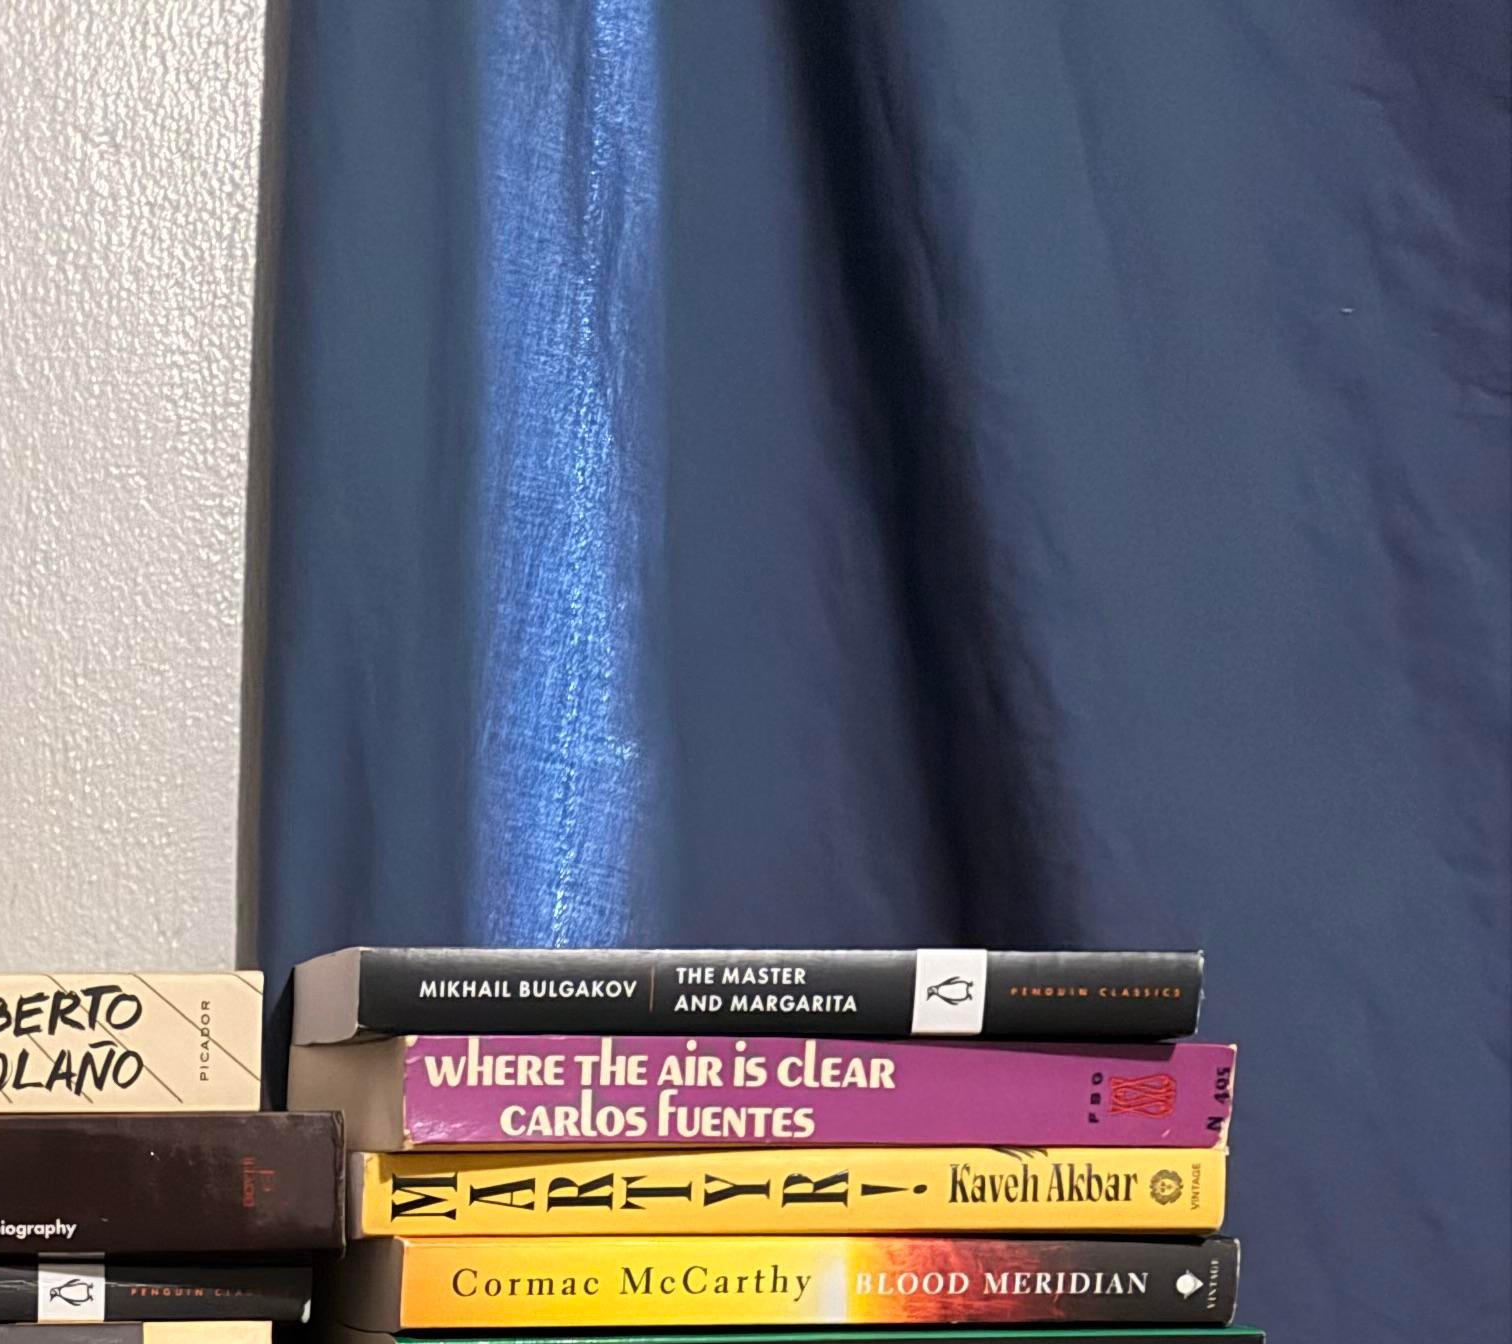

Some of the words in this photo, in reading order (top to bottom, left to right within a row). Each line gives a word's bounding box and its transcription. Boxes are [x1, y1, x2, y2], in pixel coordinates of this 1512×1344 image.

[676, 967, 716, 984] THE
[722, 968, 805, 984] MASTER
[420, 981, 510, 997] MIKHAIL
[520, 981, 636, 997] BULGAKOV
[675, 995, 722, 1011] AND
[731, 995, 856, 1011] MARGARITA
[199, 999, 211, 1082] PICADOR
[453, 1268, 598, 1296] Cormac
[620, 1265, 810, 1302] McCarthy
[855, 1271, 970, 1295] BLOOD
[983, 1272, 1147, 1294] MERIDIAN
